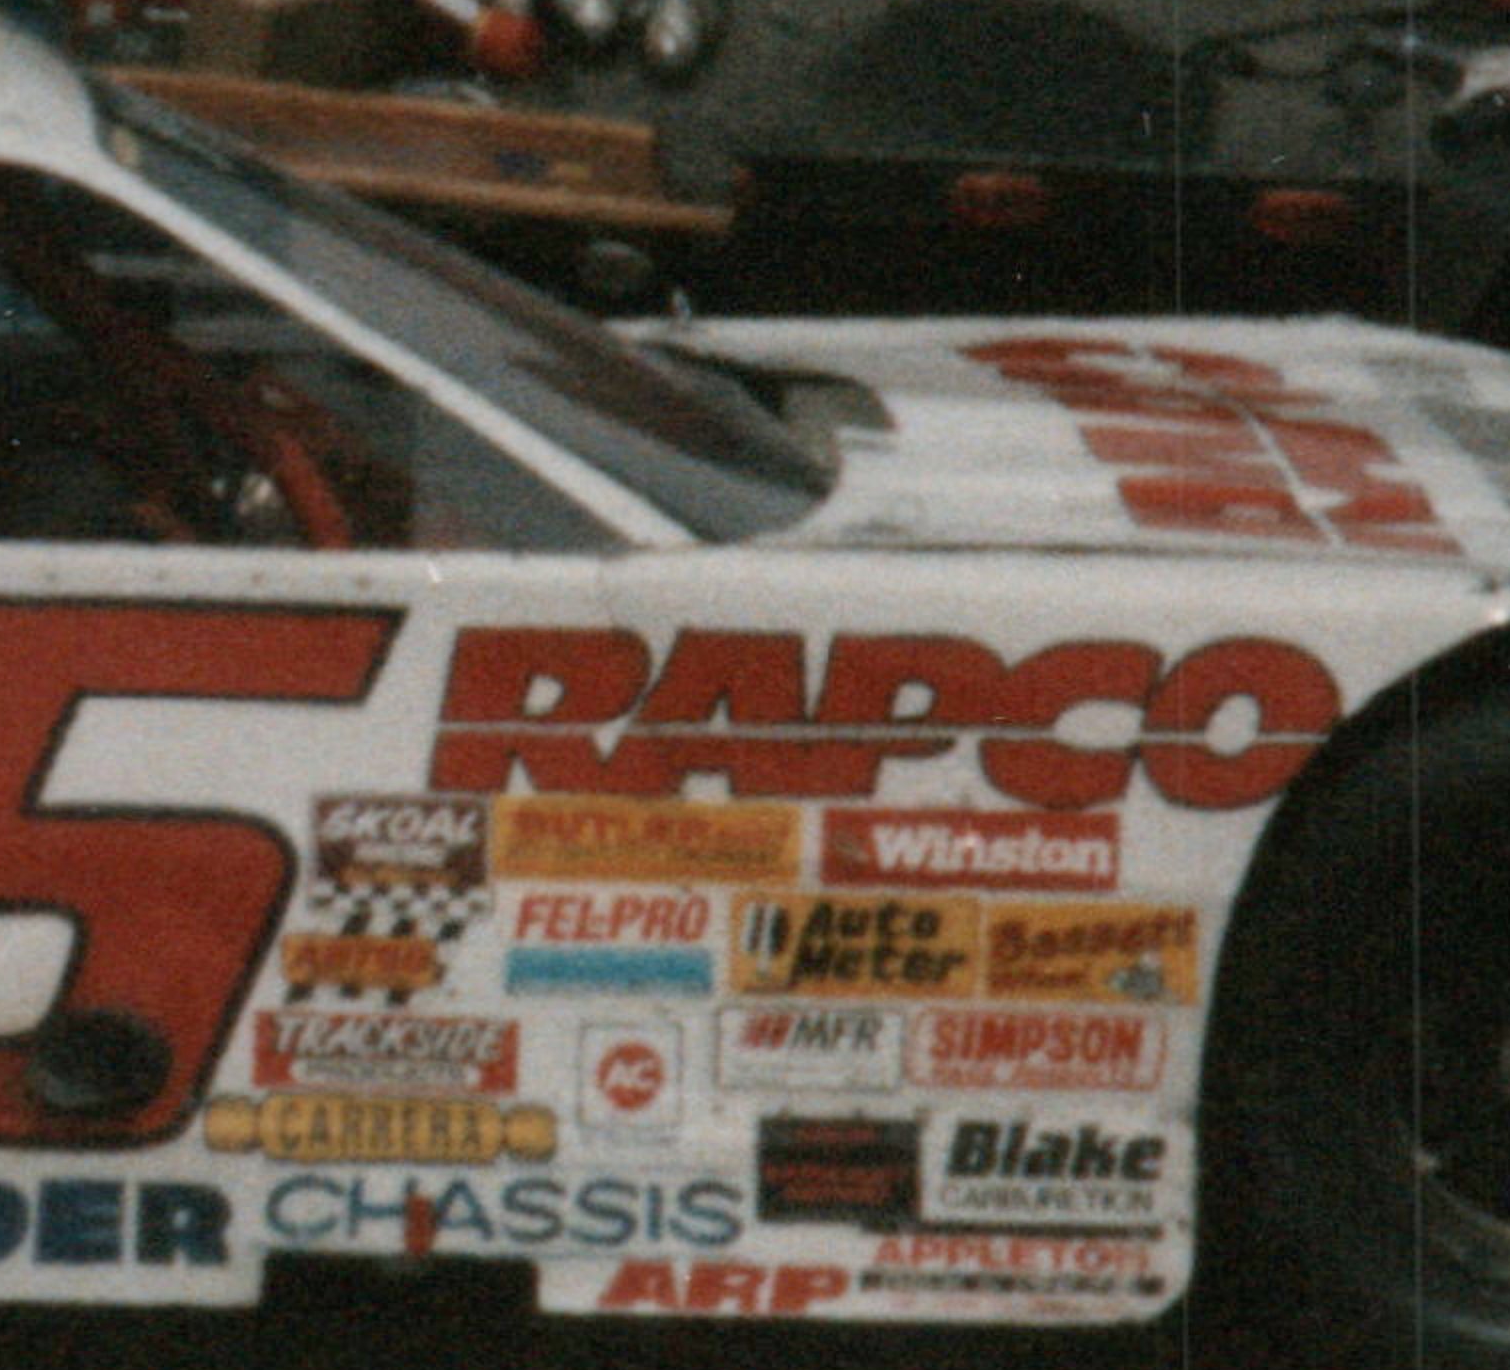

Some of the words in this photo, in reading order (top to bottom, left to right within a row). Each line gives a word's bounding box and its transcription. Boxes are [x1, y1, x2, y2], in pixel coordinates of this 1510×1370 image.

[428, 626, 1344, 810] RAPCO
[872, 824, 1113, 876] Winston
[808, 901, 942, 939] Auto
[795, 937, 968, 984] Meter
[930, 1015, 1145, 1063] SIMPSON
[947, 1119, 1167, 1181] Blake
[264, 1172, 743, 1249] CHASSIS
[598, 1256, 852, 1314] ARP
